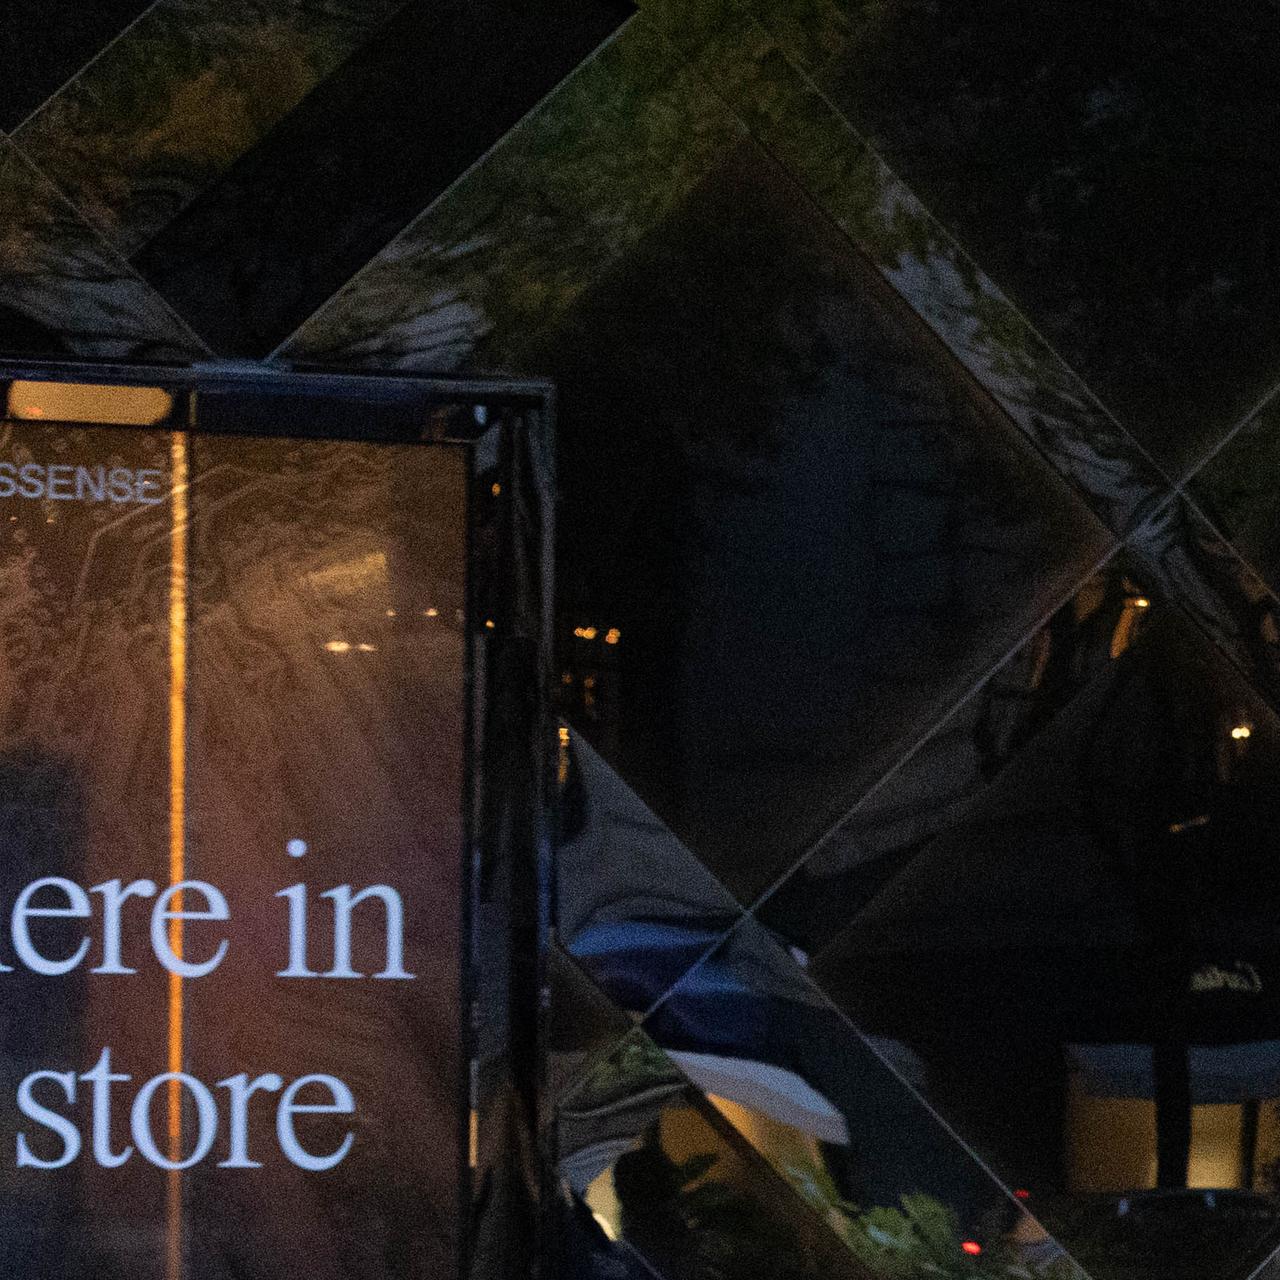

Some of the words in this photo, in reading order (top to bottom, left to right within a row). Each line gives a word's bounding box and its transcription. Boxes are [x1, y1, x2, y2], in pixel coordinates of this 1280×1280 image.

[0, 462, 163, 505] SSENSE
[0, 876, 231, 979] ere
[274, 838, 417, 980] in
[15, 1045, 357, 1172] store
